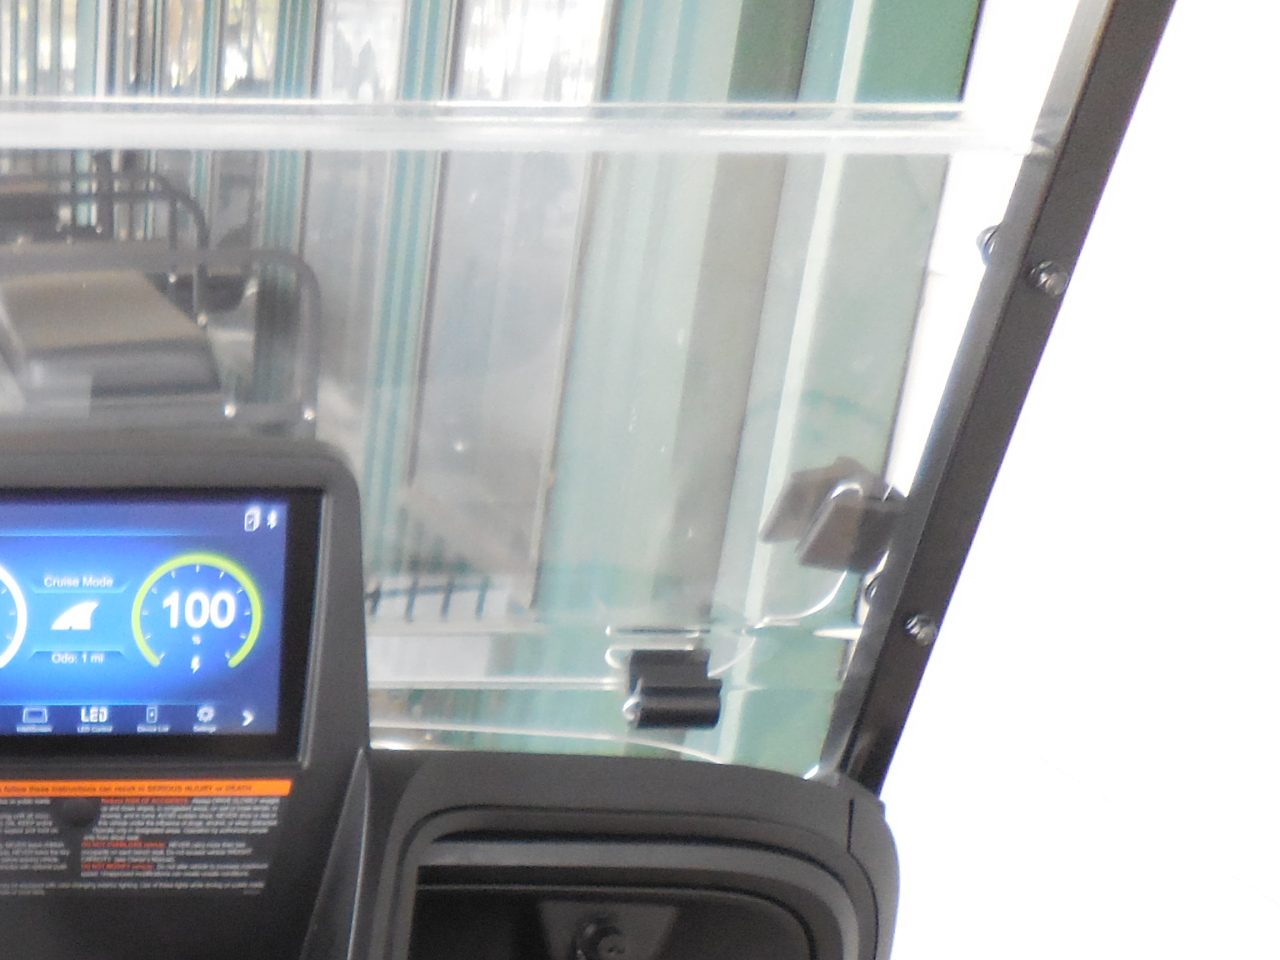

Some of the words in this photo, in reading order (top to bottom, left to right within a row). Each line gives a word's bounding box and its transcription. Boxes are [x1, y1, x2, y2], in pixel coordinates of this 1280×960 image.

[43, 575, 79, 587] Cruise
[82, 575, 113, 587] Mode
[163, 591, 235, 628] 100
[82, 652, 87, 663] 1
[81, 706, 108, 722] LED
